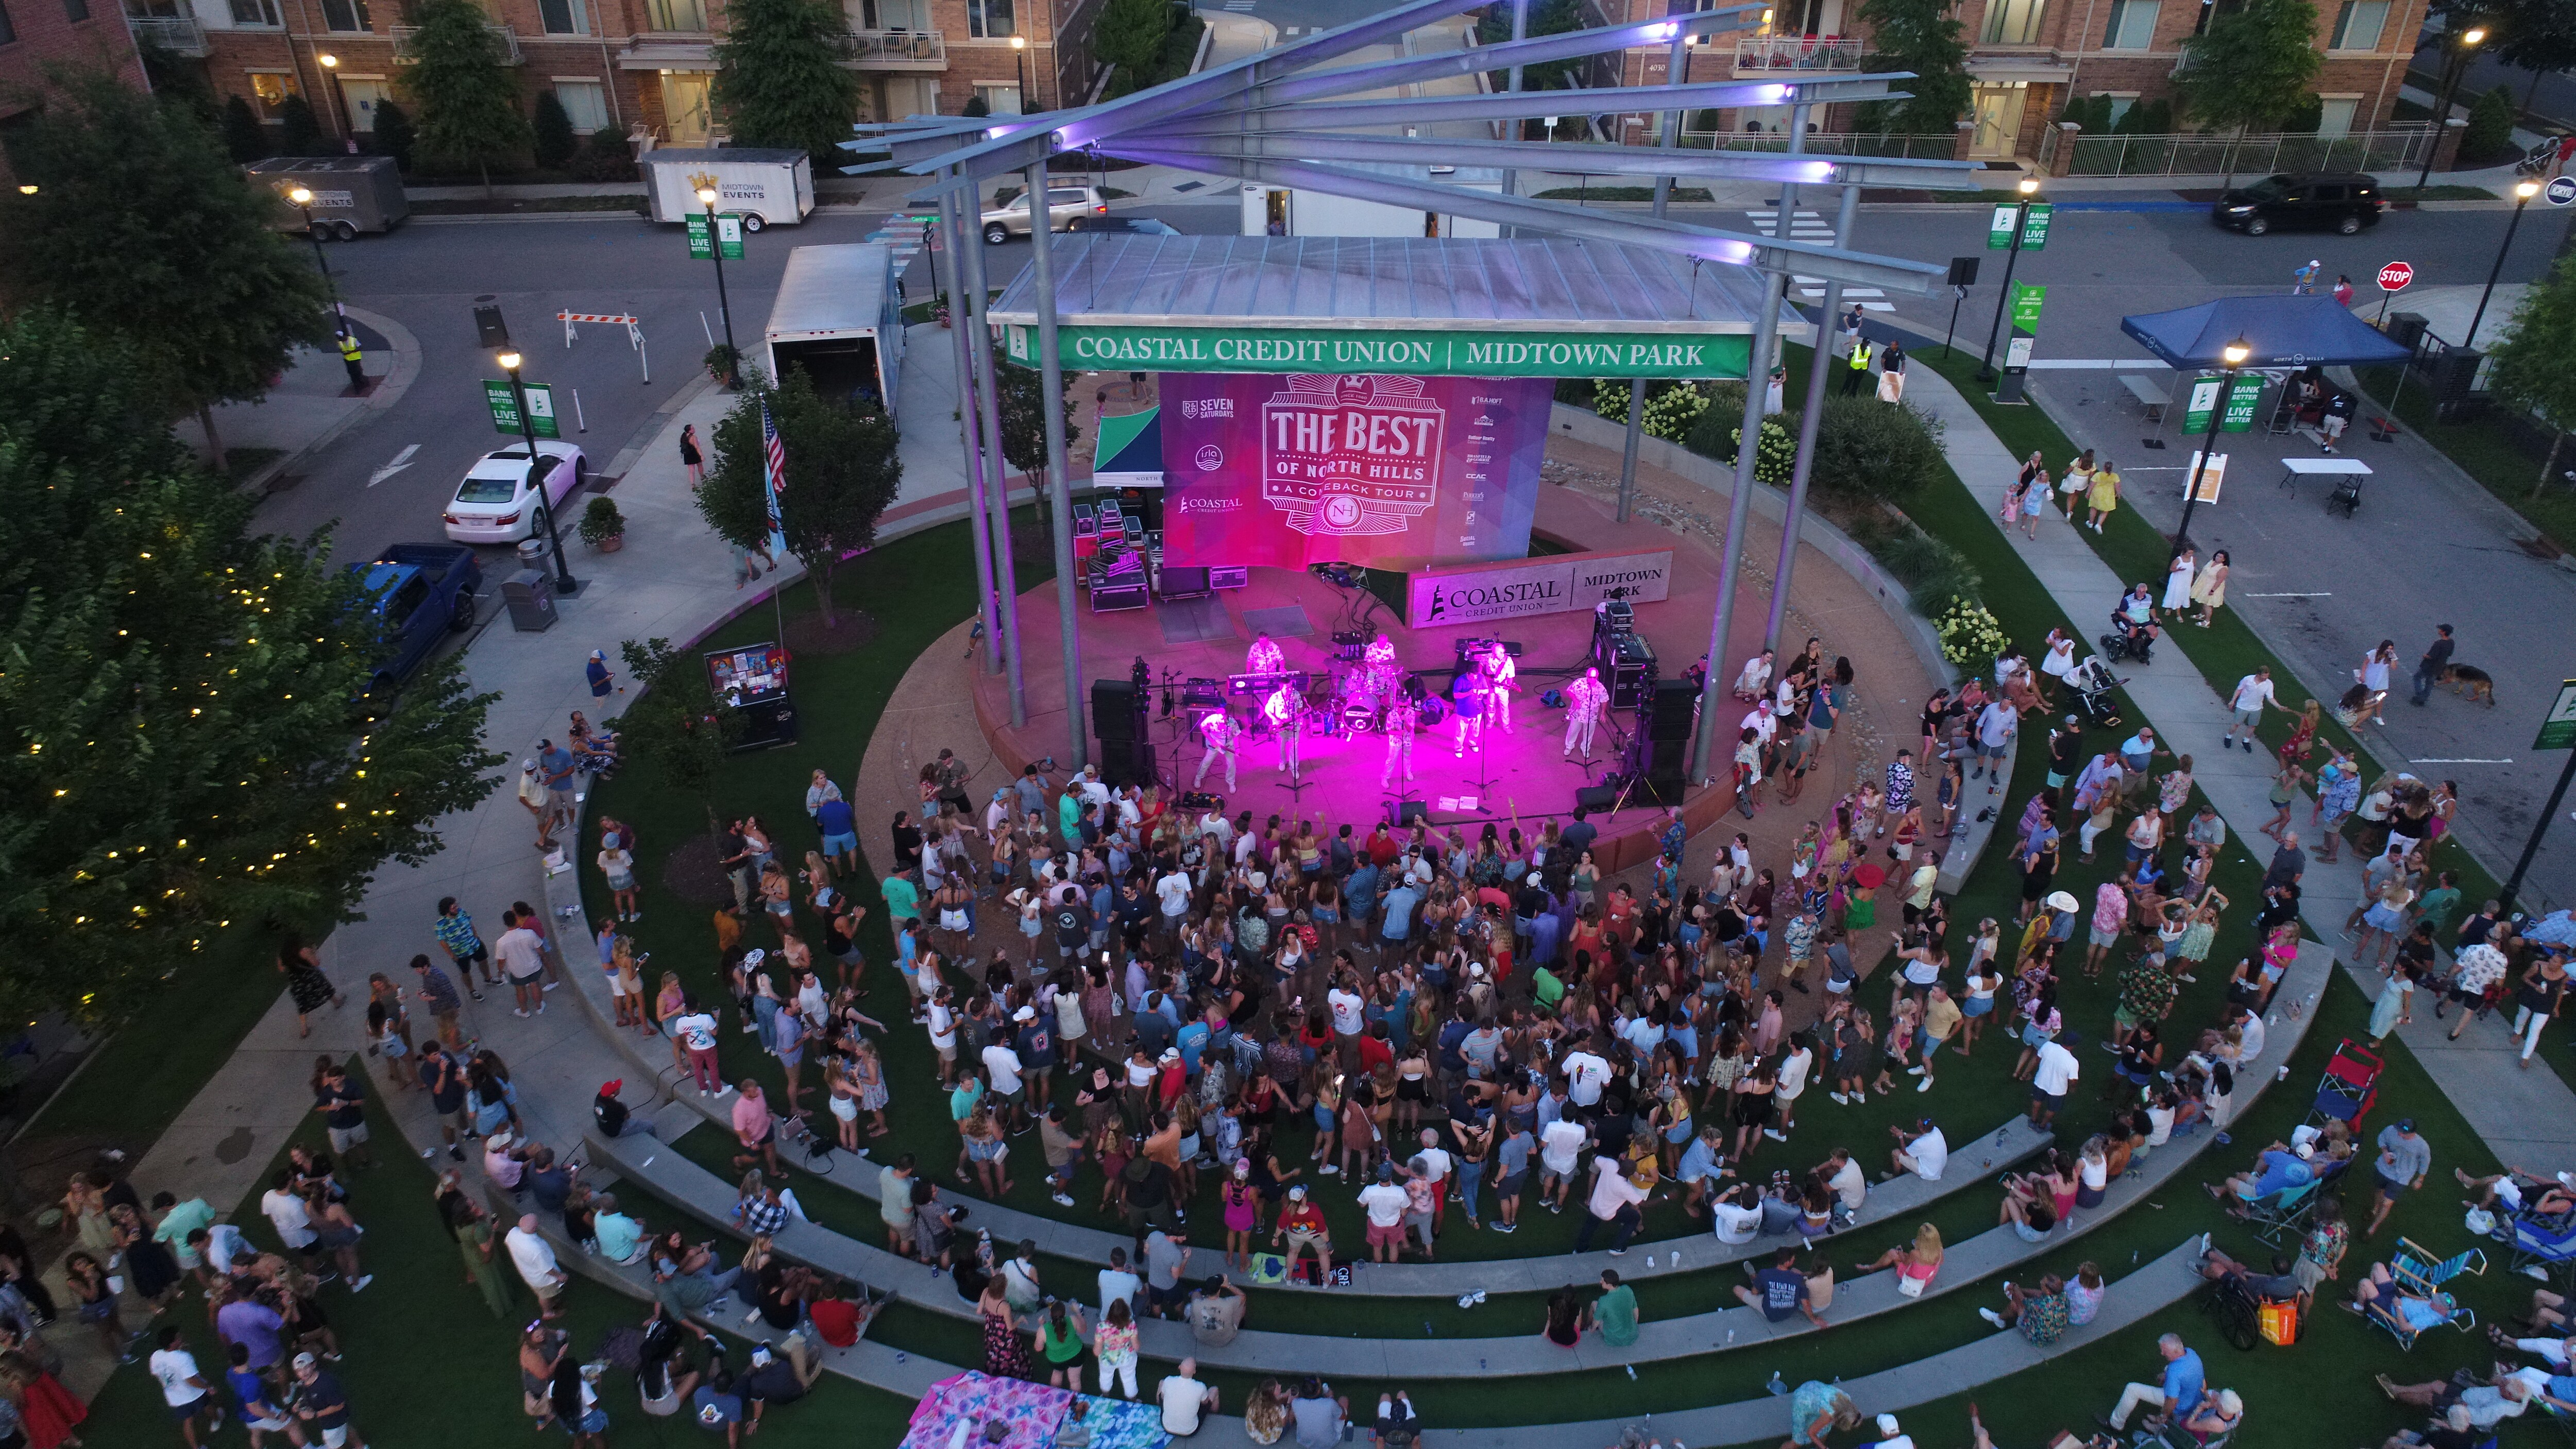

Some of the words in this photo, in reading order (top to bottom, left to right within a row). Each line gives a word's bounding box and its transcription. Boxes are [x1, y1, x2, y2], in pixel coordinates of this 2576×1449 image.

[2025, 230, 2046, 238] LIVE
[2380, 270, 2410, 282] STOP
[1076, 337, 1207, 360] COASTAL
[1215, 338, 1327, 362] CREDIT
[1334, 340, 1432, 363] UNION
[1467, 342, 1624, 365] MIDTOWN
[1629, 344, 1705, 366] PARK
[1200, 398, 1233, 411] SEVEN
[494, 410, 517, 419] LIVE
[1200, 410, 1233, 418] SATURDAYS
[2227, 407, 2254, 416] LIVE
[1271, 412, 1338, 454] THE
[1345, 412, 1435, 457] BEST
[1201, 450, 1217, 458] isla
[1277, 462, 1299, 474] OF
[1307, 461, 1362, 478] NORTH
[1369, 465, 1424, 481] HILLS
[1376, 488, 1414, 498] TOUR
[1190, 498, 1243, 508] COASTAL
[1332, 505, 1355, 517] NH
[1584, 569, 1663, 587] MIDTOWN
[1450, 580, 1562, 608] COASTAL
[1603, 585, 1641, 599] PRK
[1465, 606, 1506, 618] CREDIT
[1509, 602, 1543, 613] UNION
